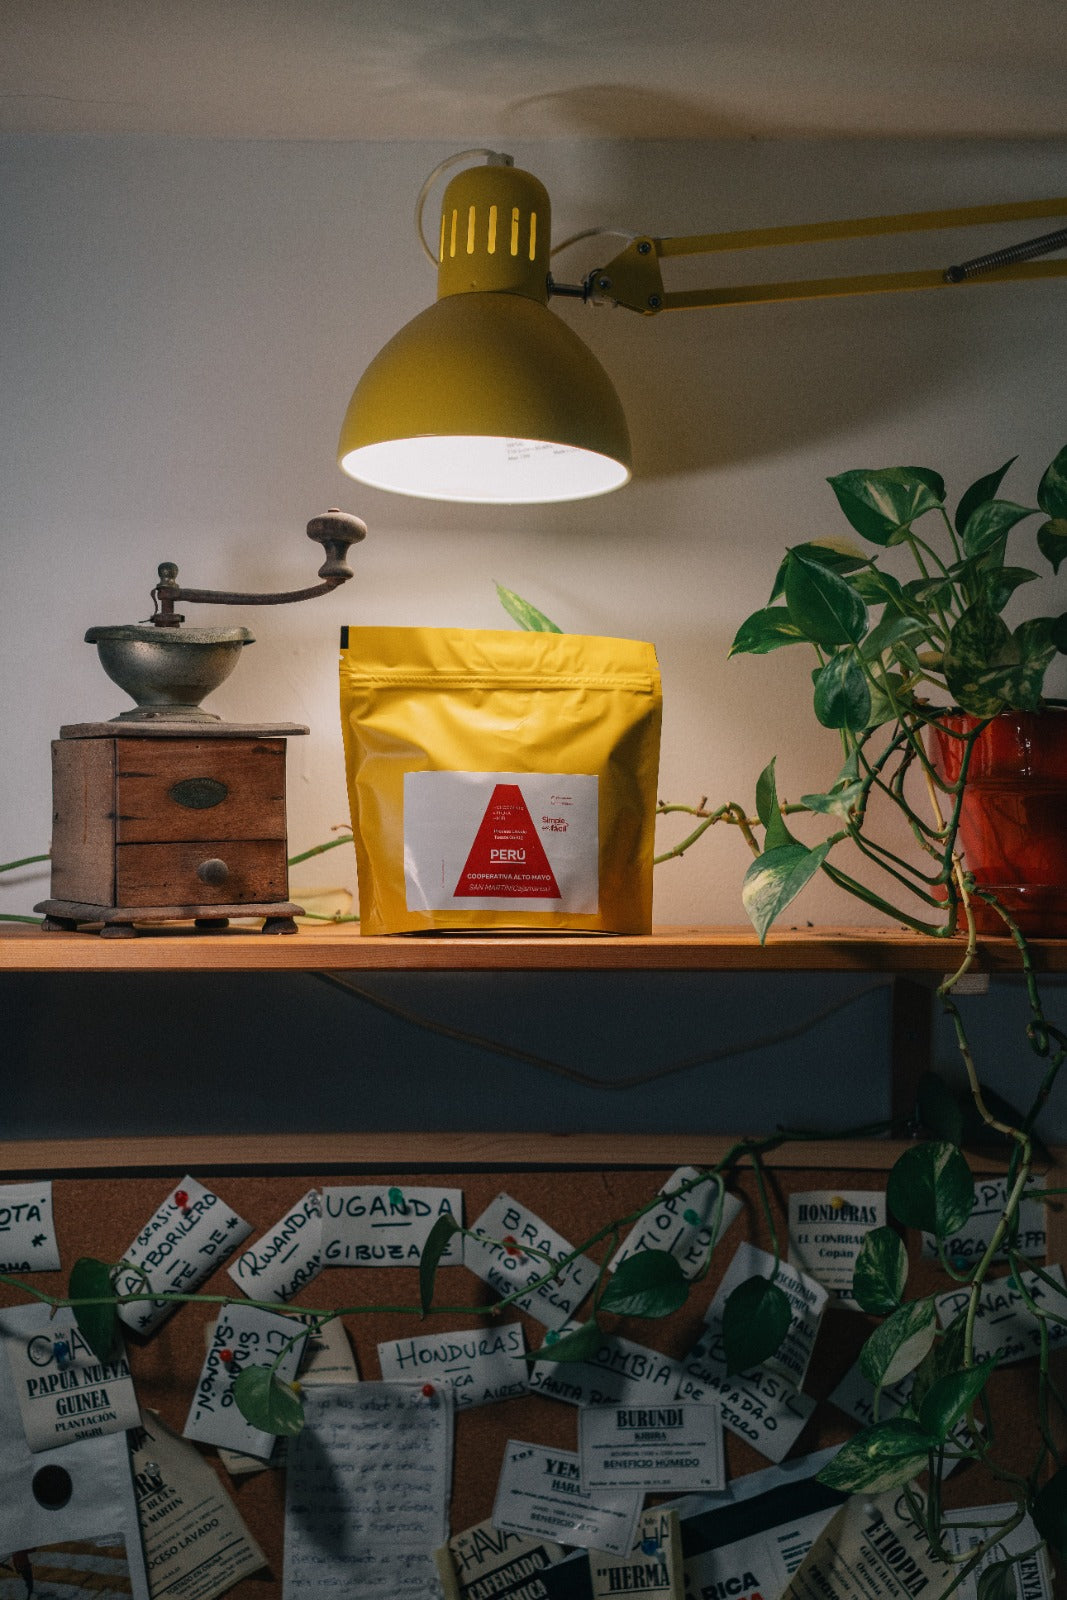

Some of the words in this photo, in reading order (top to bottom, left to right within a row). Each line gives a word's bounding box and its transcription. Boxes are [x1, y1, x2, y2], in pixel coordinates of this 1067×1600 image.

[490, 848, 526, 861] PERÚ
[467, 873, 513, 881] COOPERATIVA
[326, 1195, 453, 1218] UGANDA
[798, 1203, 878, 1224] HONDURAS
[199, 1229, 228, 1256] DE
[325, 1239, 453, 1261] GIBUZAE
[396, 1330, 520, 1370] HONDURAS
[82, 1358, 131, 1385] NUEVA
[55, 1389, 111, 1416] GUINEA
[685, 1382, 704, 1401] DE
[616, 1408, 683, 1428] BURUNDI
[603, 1460, 653, 1470] BENEFICIO
[178, 1517, 221, 1549] LAVADO
[864, 1519, 929, 1598] ETIOPIA
